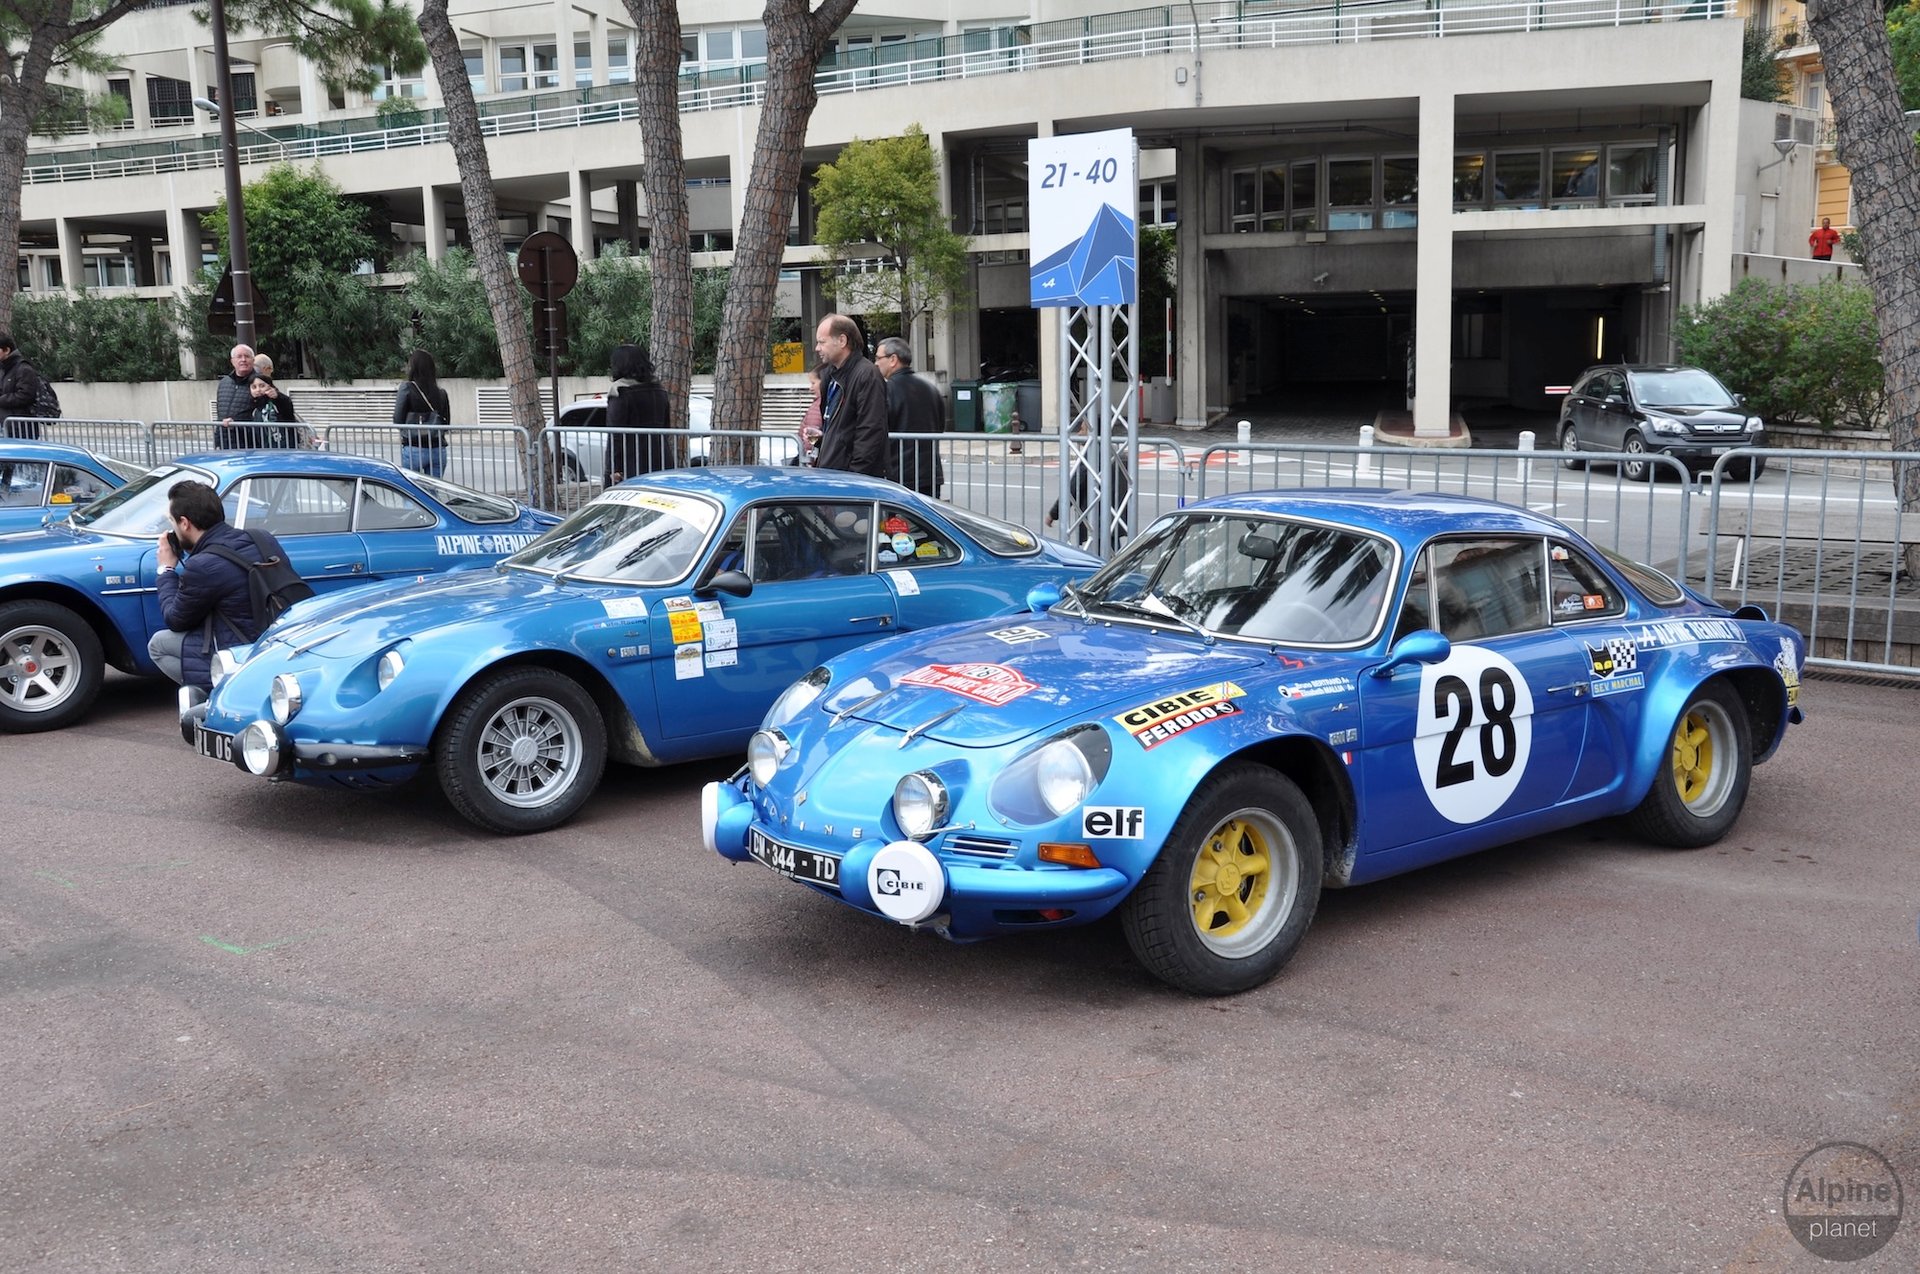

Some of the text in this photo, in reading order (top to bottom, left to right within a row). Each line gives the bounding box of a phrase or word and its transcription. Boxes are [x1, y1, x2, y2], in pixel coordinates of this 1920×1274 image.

[1041, 163, 1067, 188] 21
[1086, 157, 1117, 183] 40
[438, 535, 483, 554] ALPINE
[993, 628, 1045, 643] elf
[1652, 622, 1696, 645] ALPINE
[1687, 619, 1735, 640] RENAULT
[1611, 676, 1642, 691] MARCHAL
[1124, 690, 1214, 726] CIBIE
[1138, 705, 1218, 747] FERODO
[1434, 667, 1516, 789] 28
[216, 735, 232, 761] 06
[1085, 809, 1142, 836] elf
[772, 844, 795, 871] 344
[813, 855, 835, 880] TD
[886, 880, 924, 890] CIBIE
